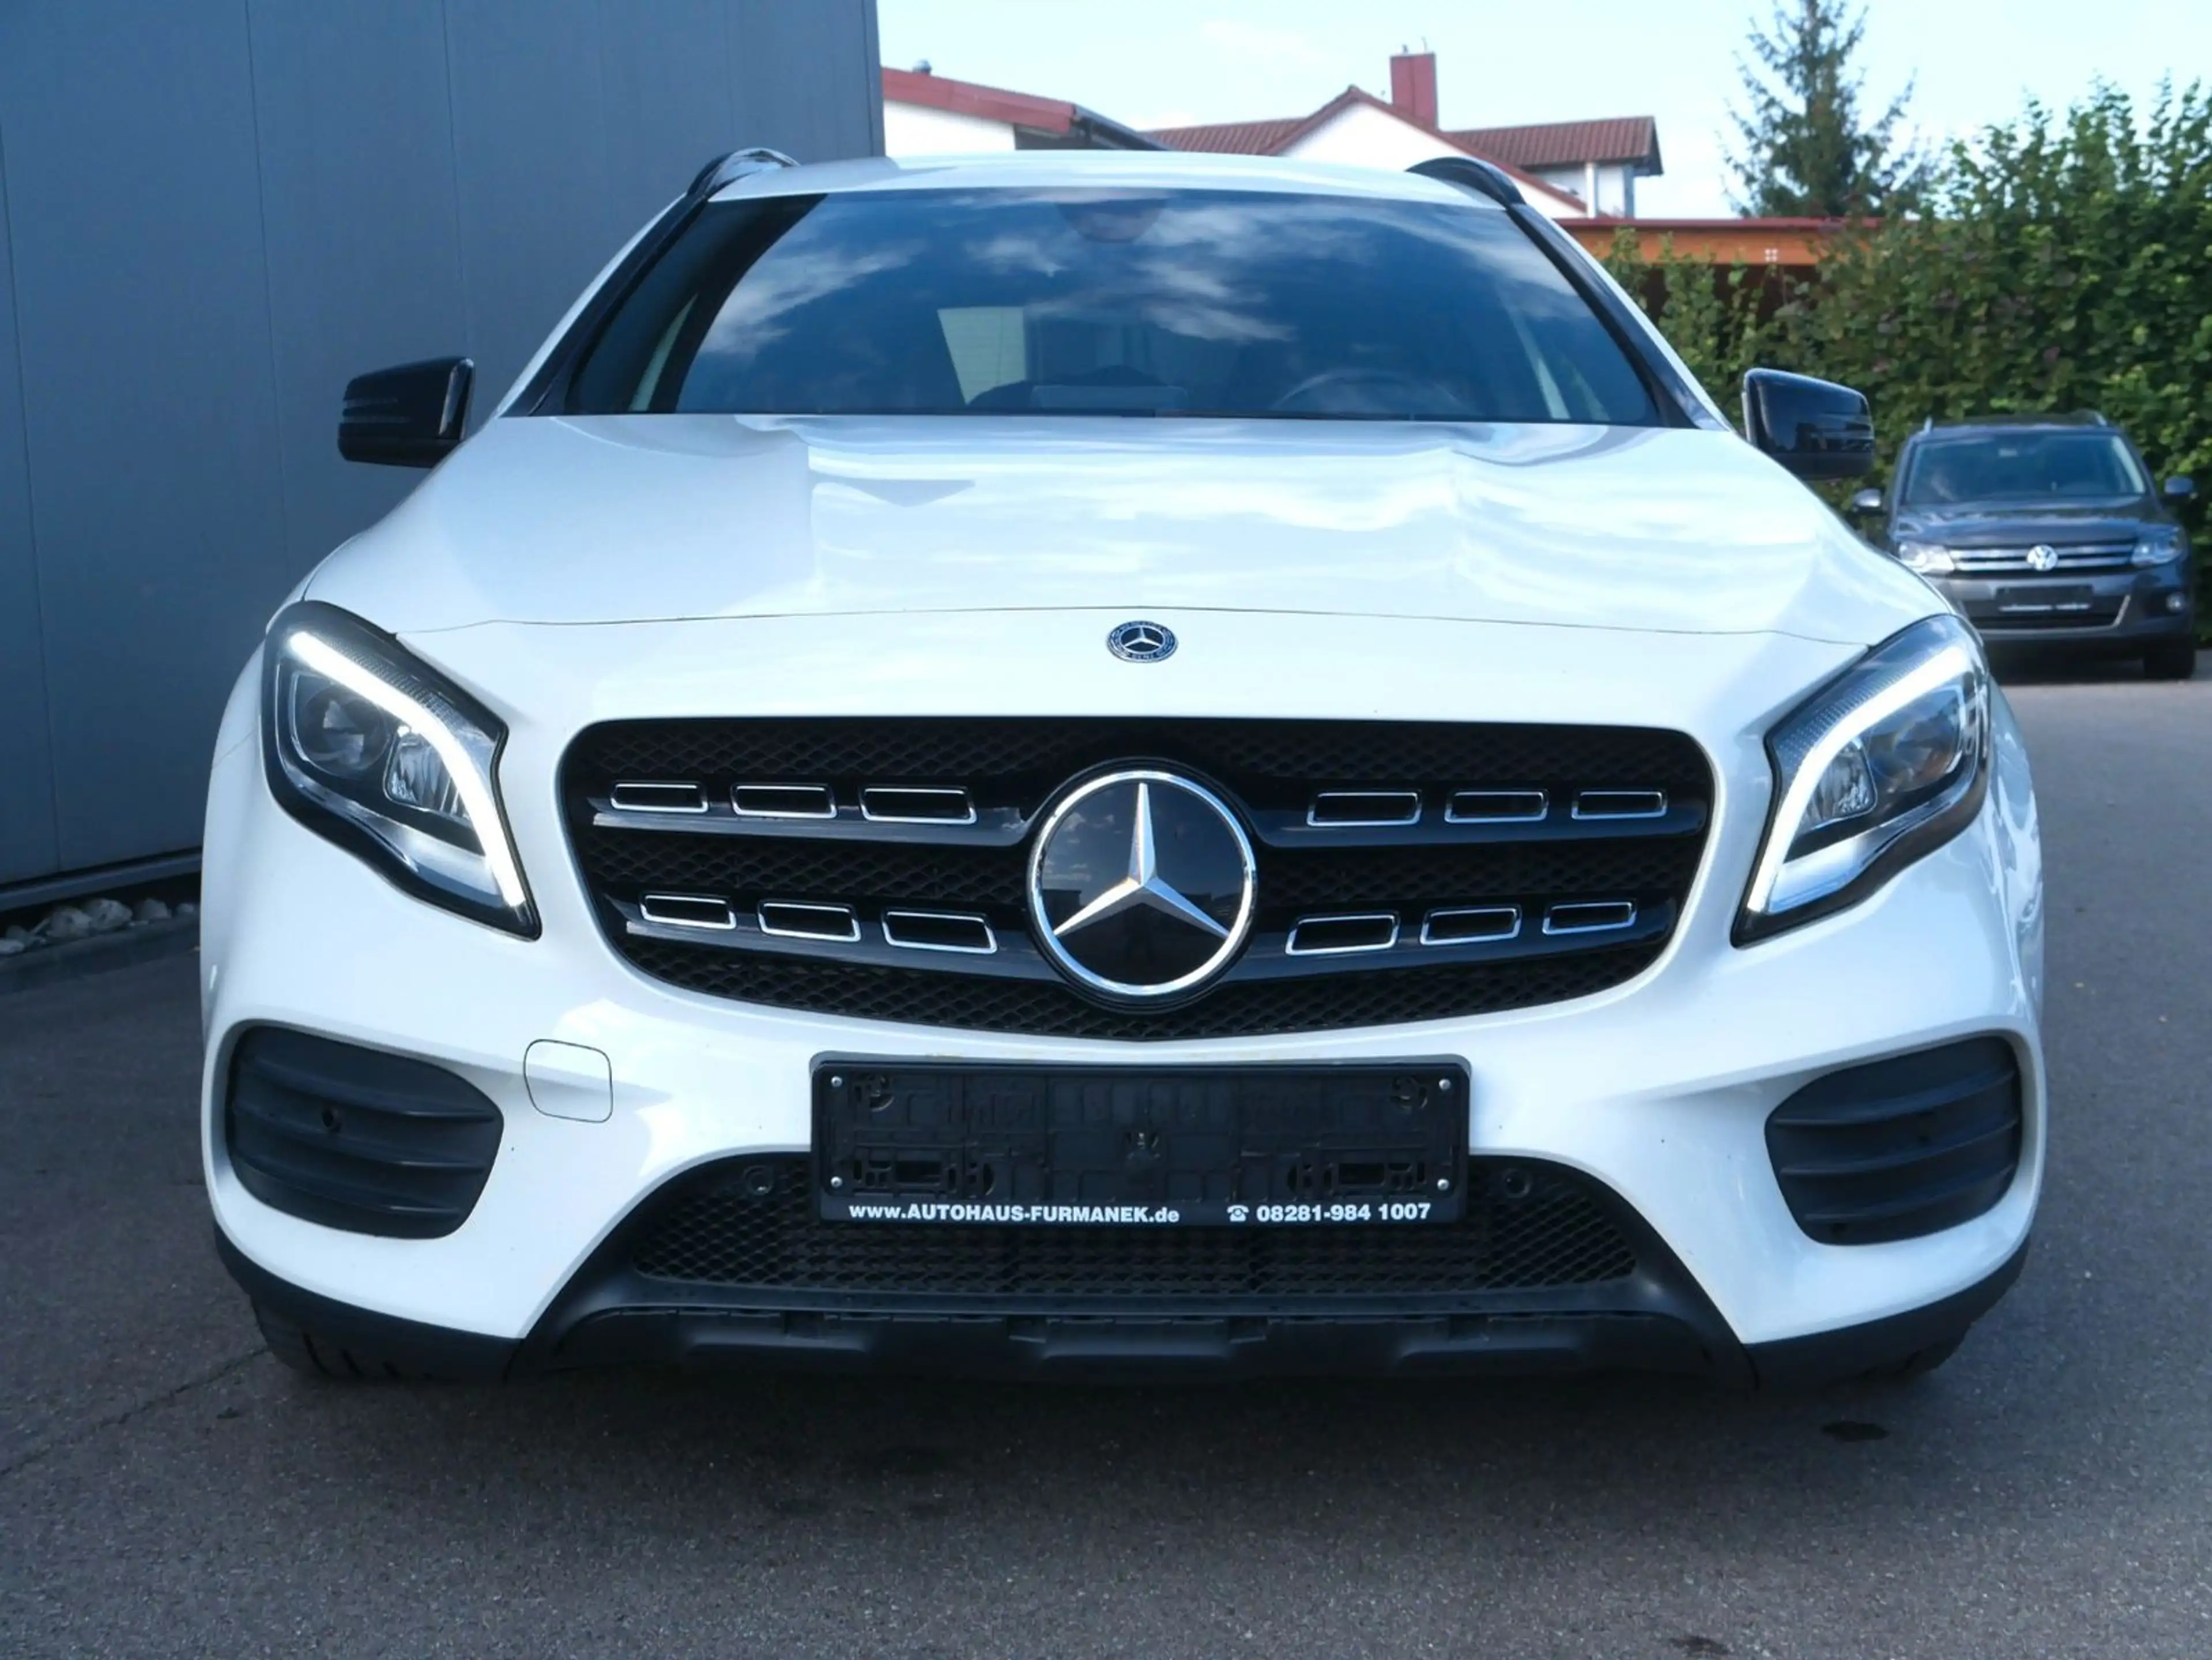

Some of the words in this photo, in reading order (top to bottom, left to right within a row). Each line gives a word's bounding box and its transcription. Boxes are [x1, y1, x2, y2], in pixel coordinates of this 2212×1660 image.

[849, 1203, 1180, 1223] www.AUTOHAUS-FURMANEK.de
[1256, 1204, 1371, 1222] 08281-984
[1378, 1202, 1431, 1220] 1007
